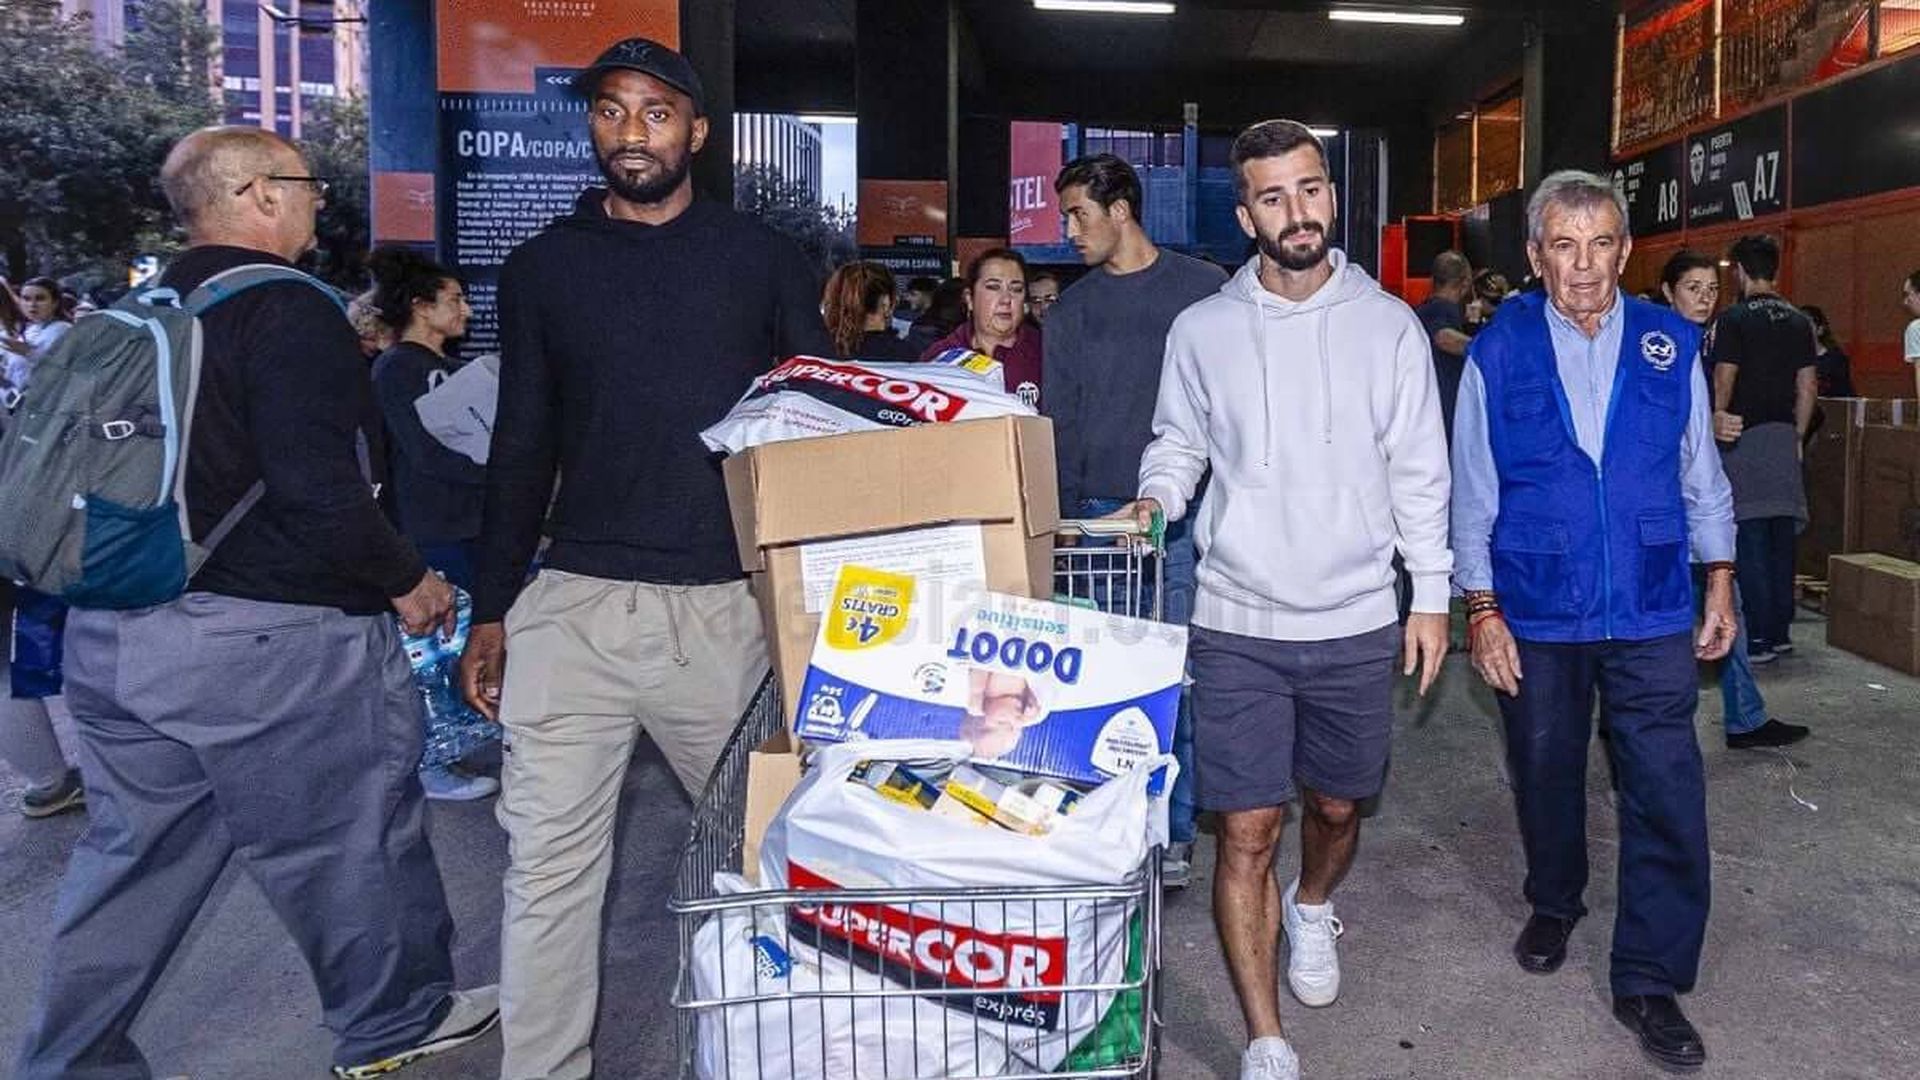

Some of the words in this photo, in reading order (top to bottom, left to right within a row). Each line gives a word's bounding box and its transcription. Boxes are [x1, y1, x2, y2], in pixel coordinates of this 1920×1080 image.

[1010, 176, 1048, 211] TEL
[1753, 150, 1780, 202] A7
[1657, 179, 1679, 222] A8
[843, 598, 898, 617] GRATIS
[947, 627, 1083, 685] DODOT
[974, 993, 1047, 1028] exprés
